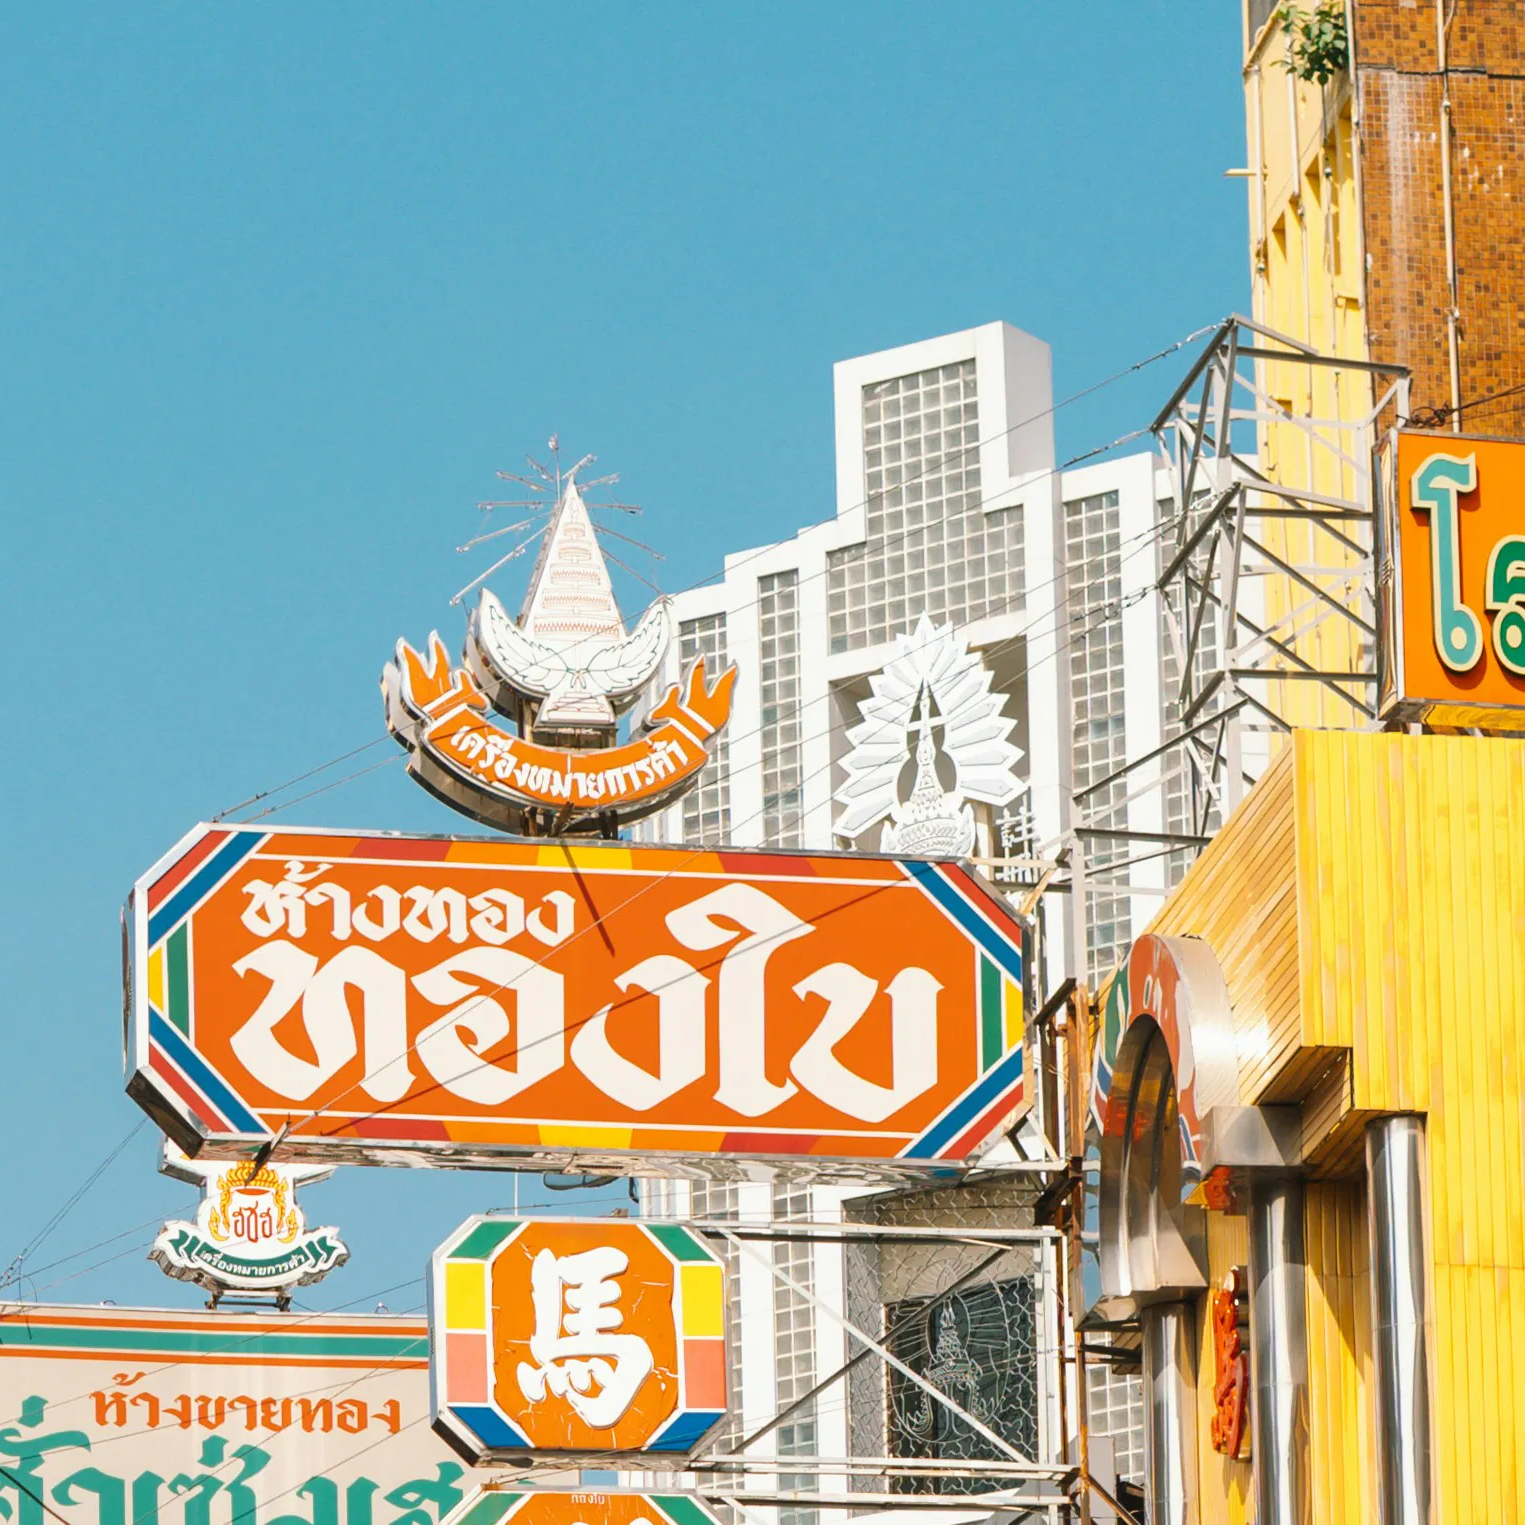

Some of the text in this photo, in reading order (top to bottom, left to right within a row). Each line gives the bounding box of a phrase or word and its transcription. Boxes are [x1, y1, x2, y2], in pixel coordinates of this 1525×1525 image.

[239, 860, 576, 947] ห้างทอง
[229, 882, 945, 1123] ทองใบ
[88, 1372, 401, 1434] ห้างขายทอง
